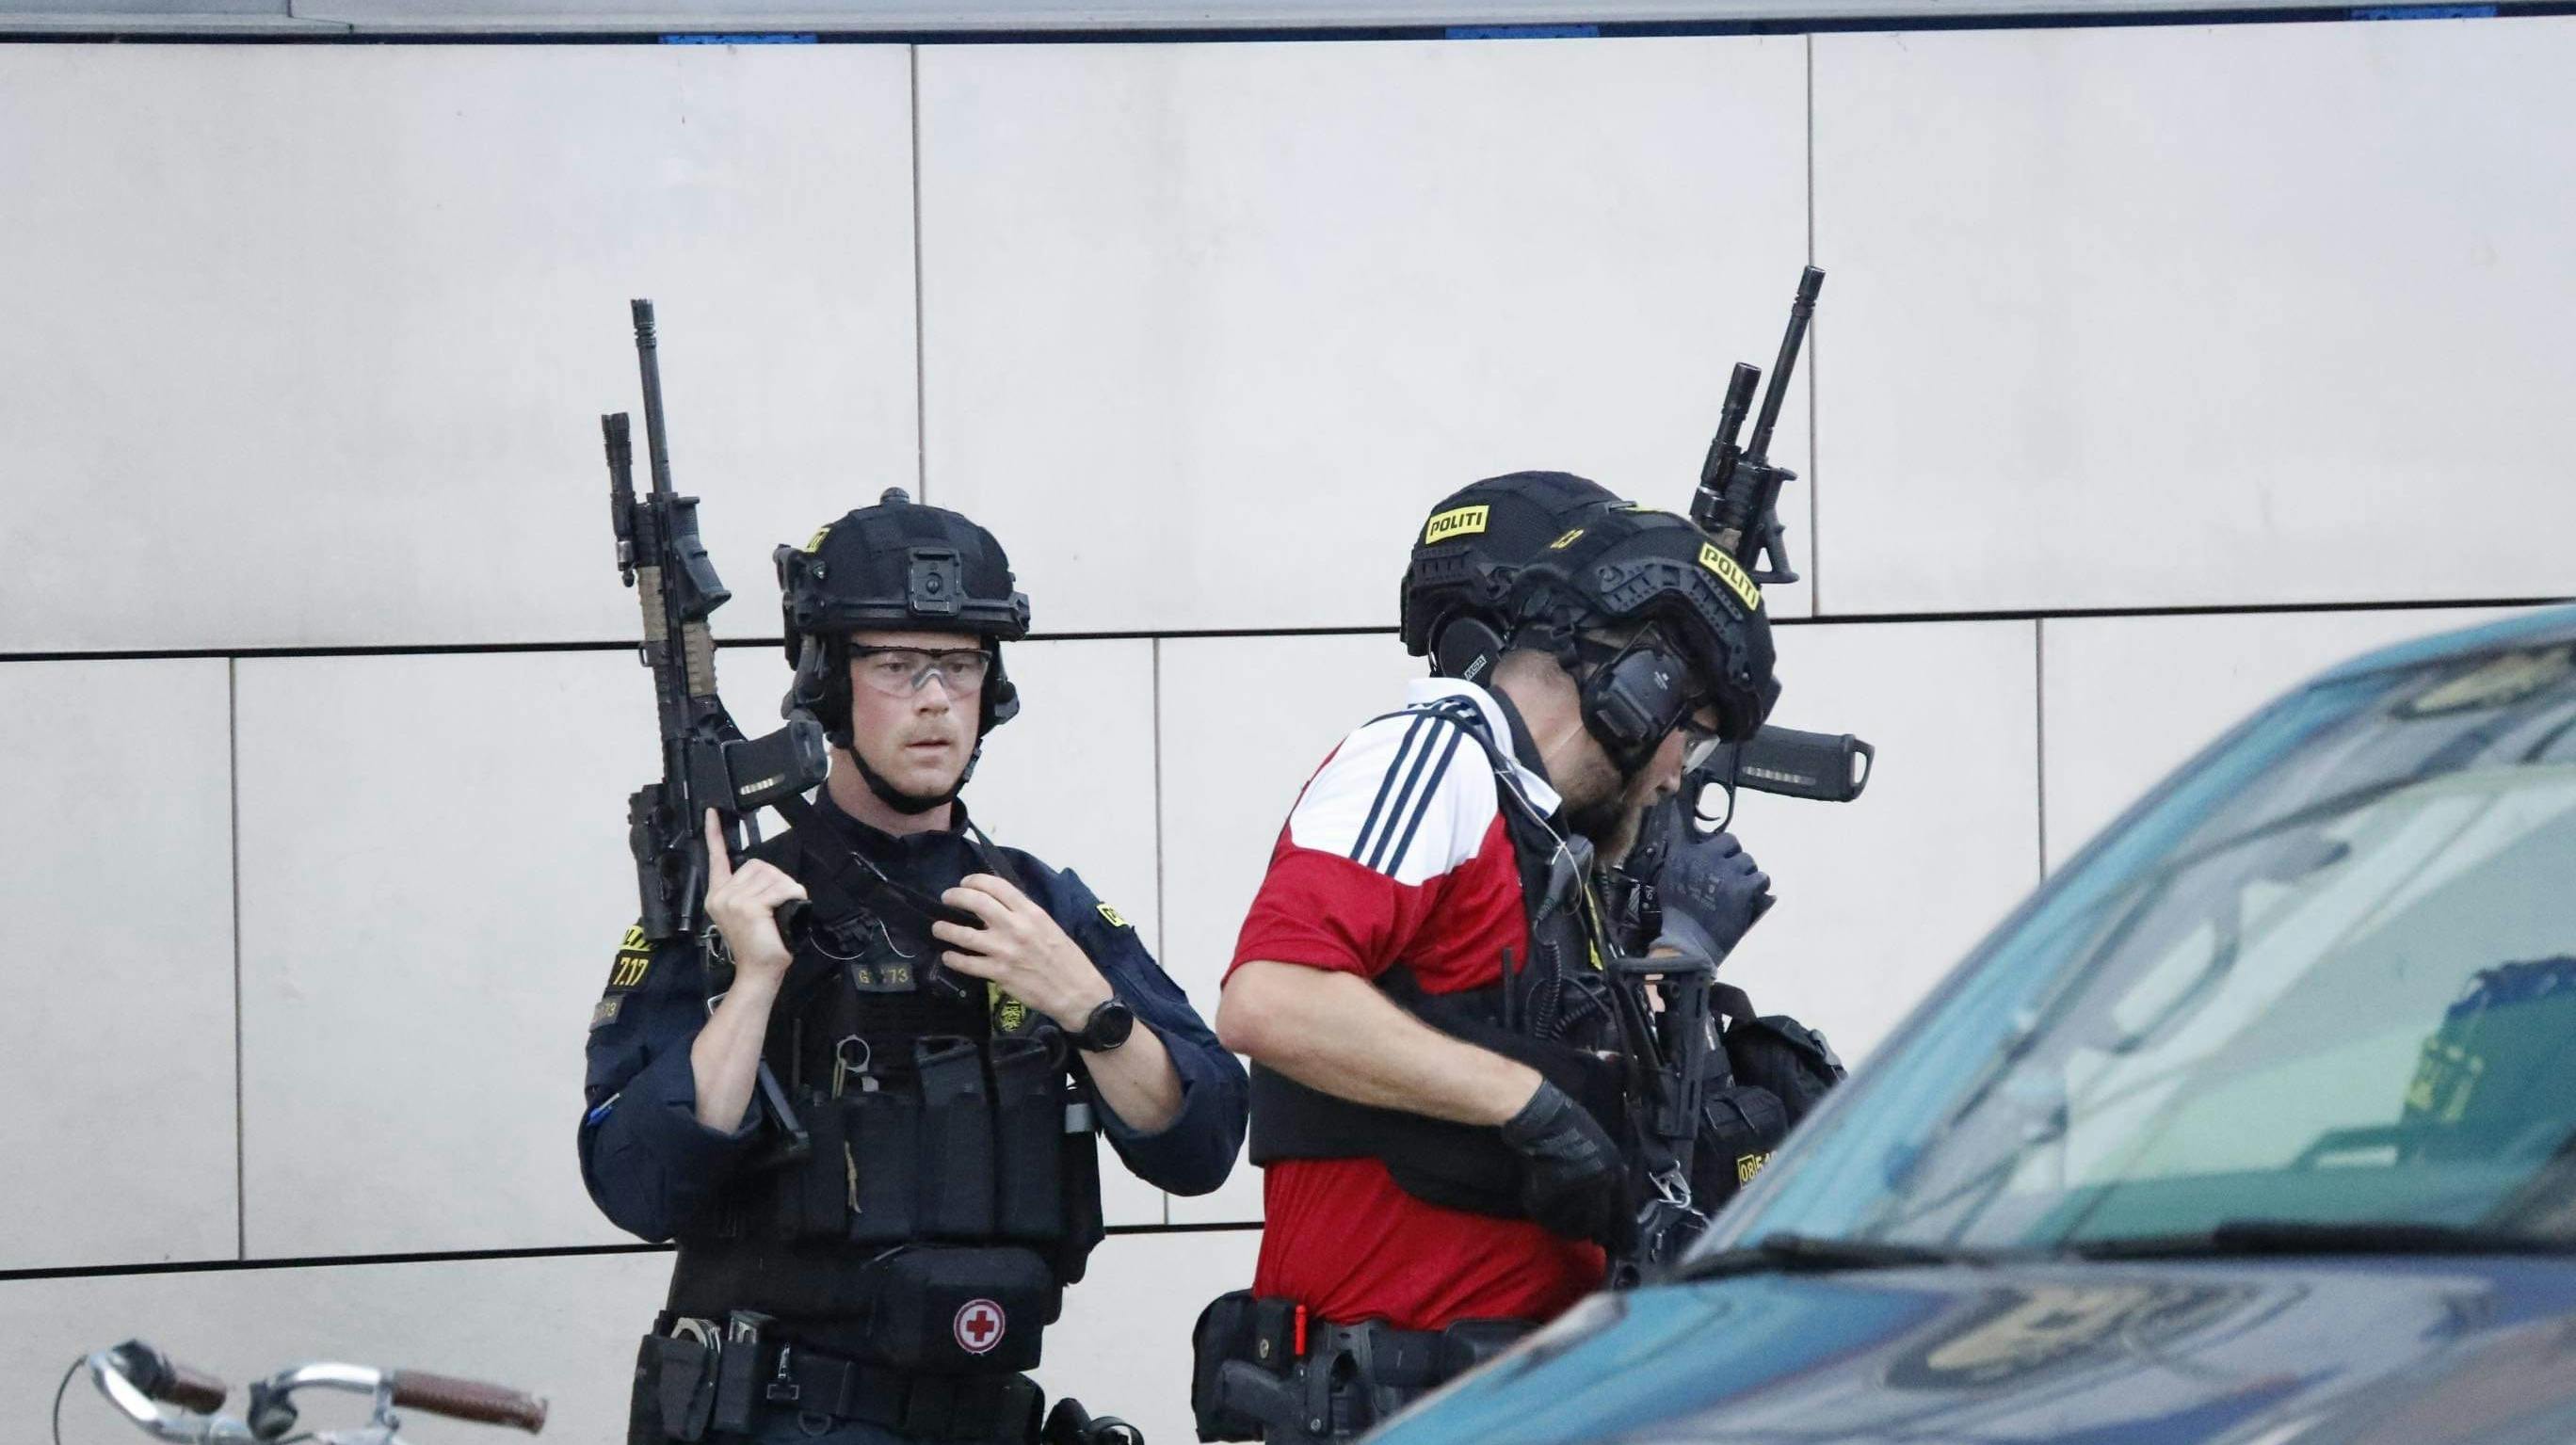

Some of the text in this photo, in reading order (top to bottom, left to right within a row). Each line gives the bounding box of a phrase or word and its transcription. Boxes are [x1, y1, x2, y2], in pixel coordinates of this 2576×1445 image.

[1429, 511, 1483, 537] POLITI
[1703, 547, 1757, 605] POLITI
[1465, 657, 1486, 678] MSA
